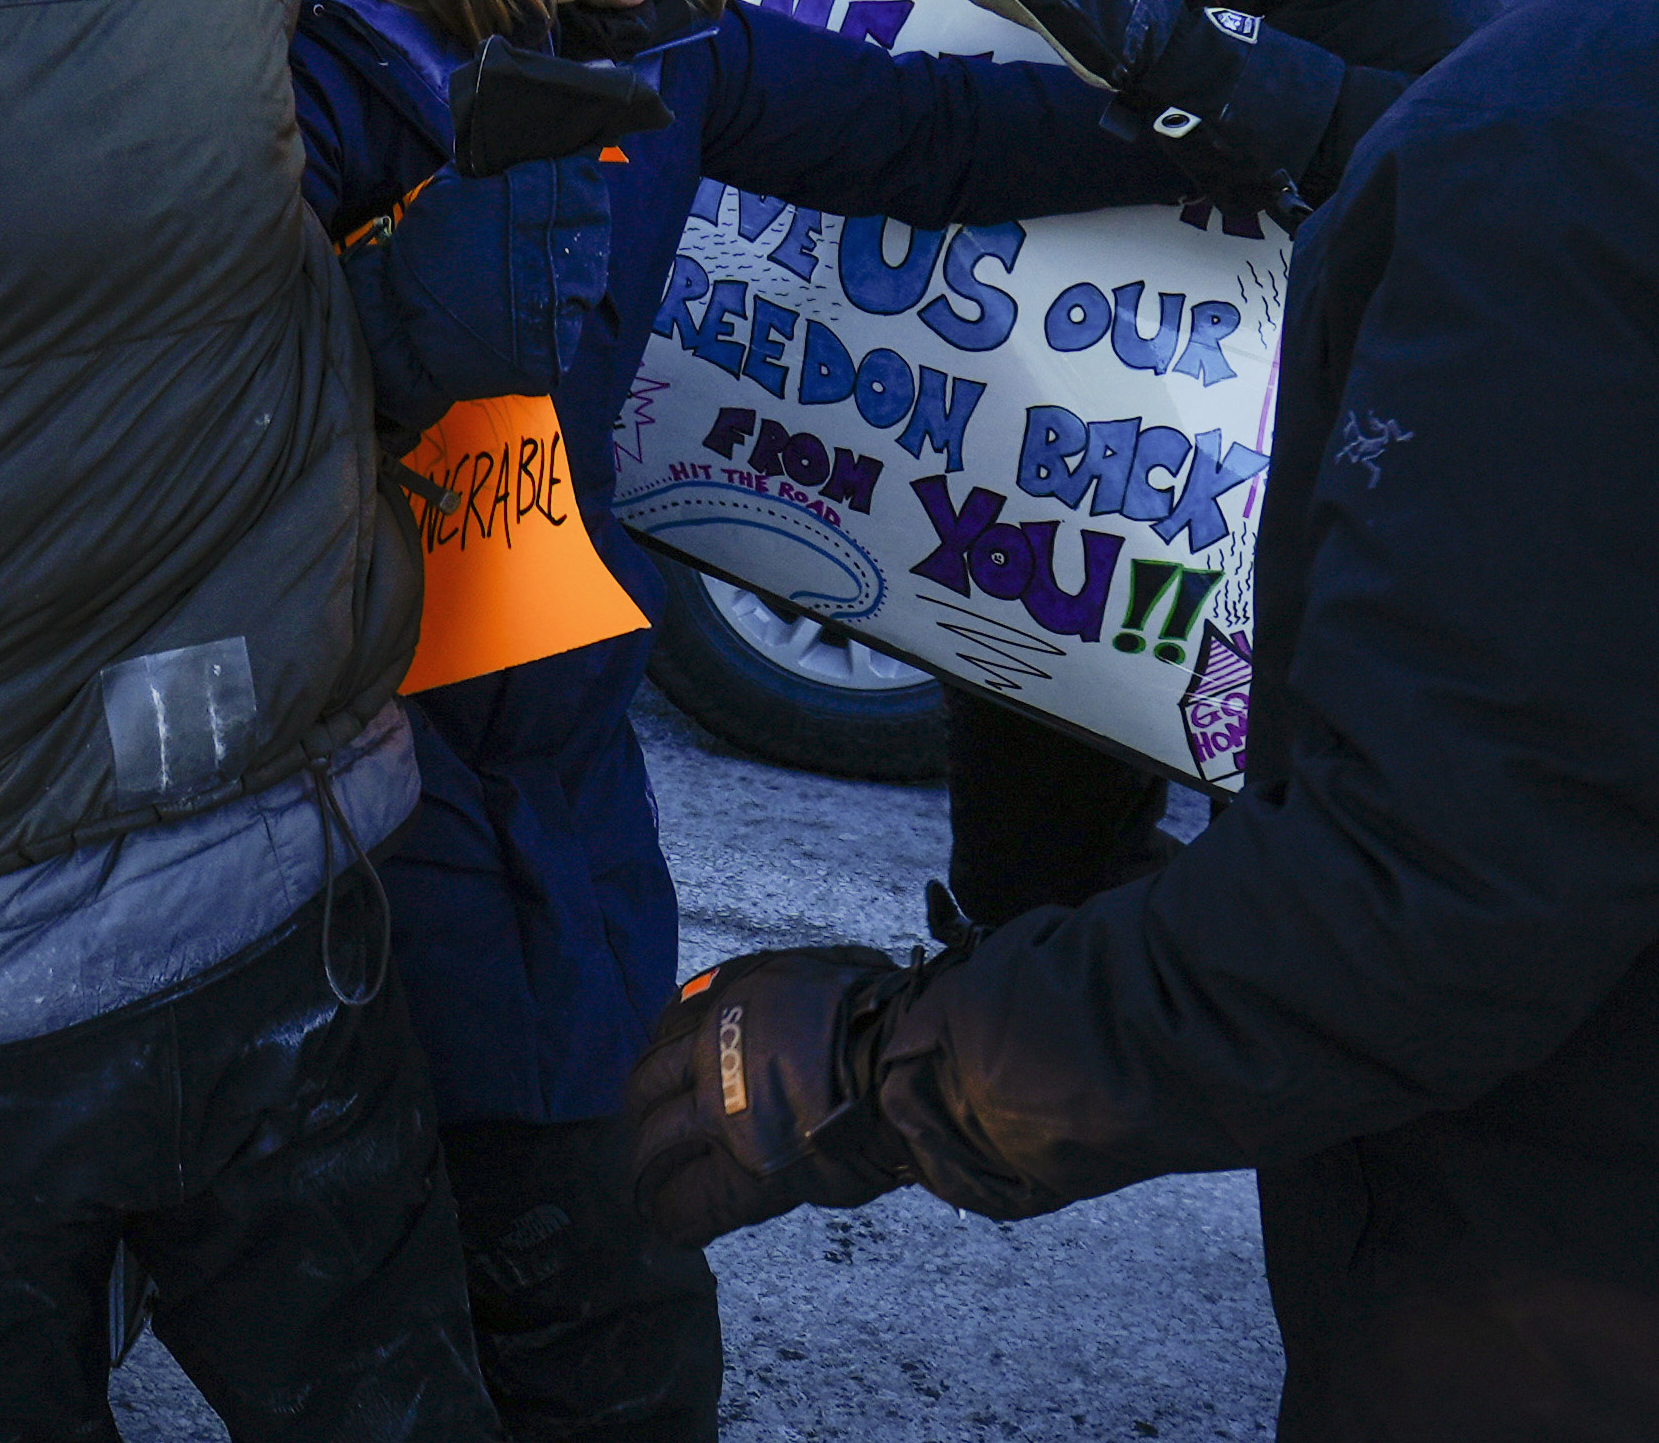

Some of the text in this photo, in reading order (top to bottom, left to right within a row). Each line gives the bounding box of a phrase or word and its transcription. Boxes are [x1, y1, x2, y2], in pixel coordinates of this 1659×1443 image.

[837, 213, 1027, 353] US
[1044, 280, 1242, 388] OUR
[650, 253, 1273, 554] REEDOM BACK
[668, 461, 713, 482] HIT
[720, 466, 771, 494] THE
[701, 406, 885, 516] FROM
[1190, 691, 1251, 730] GO
[1191, 714, 1250, 764] HOM
